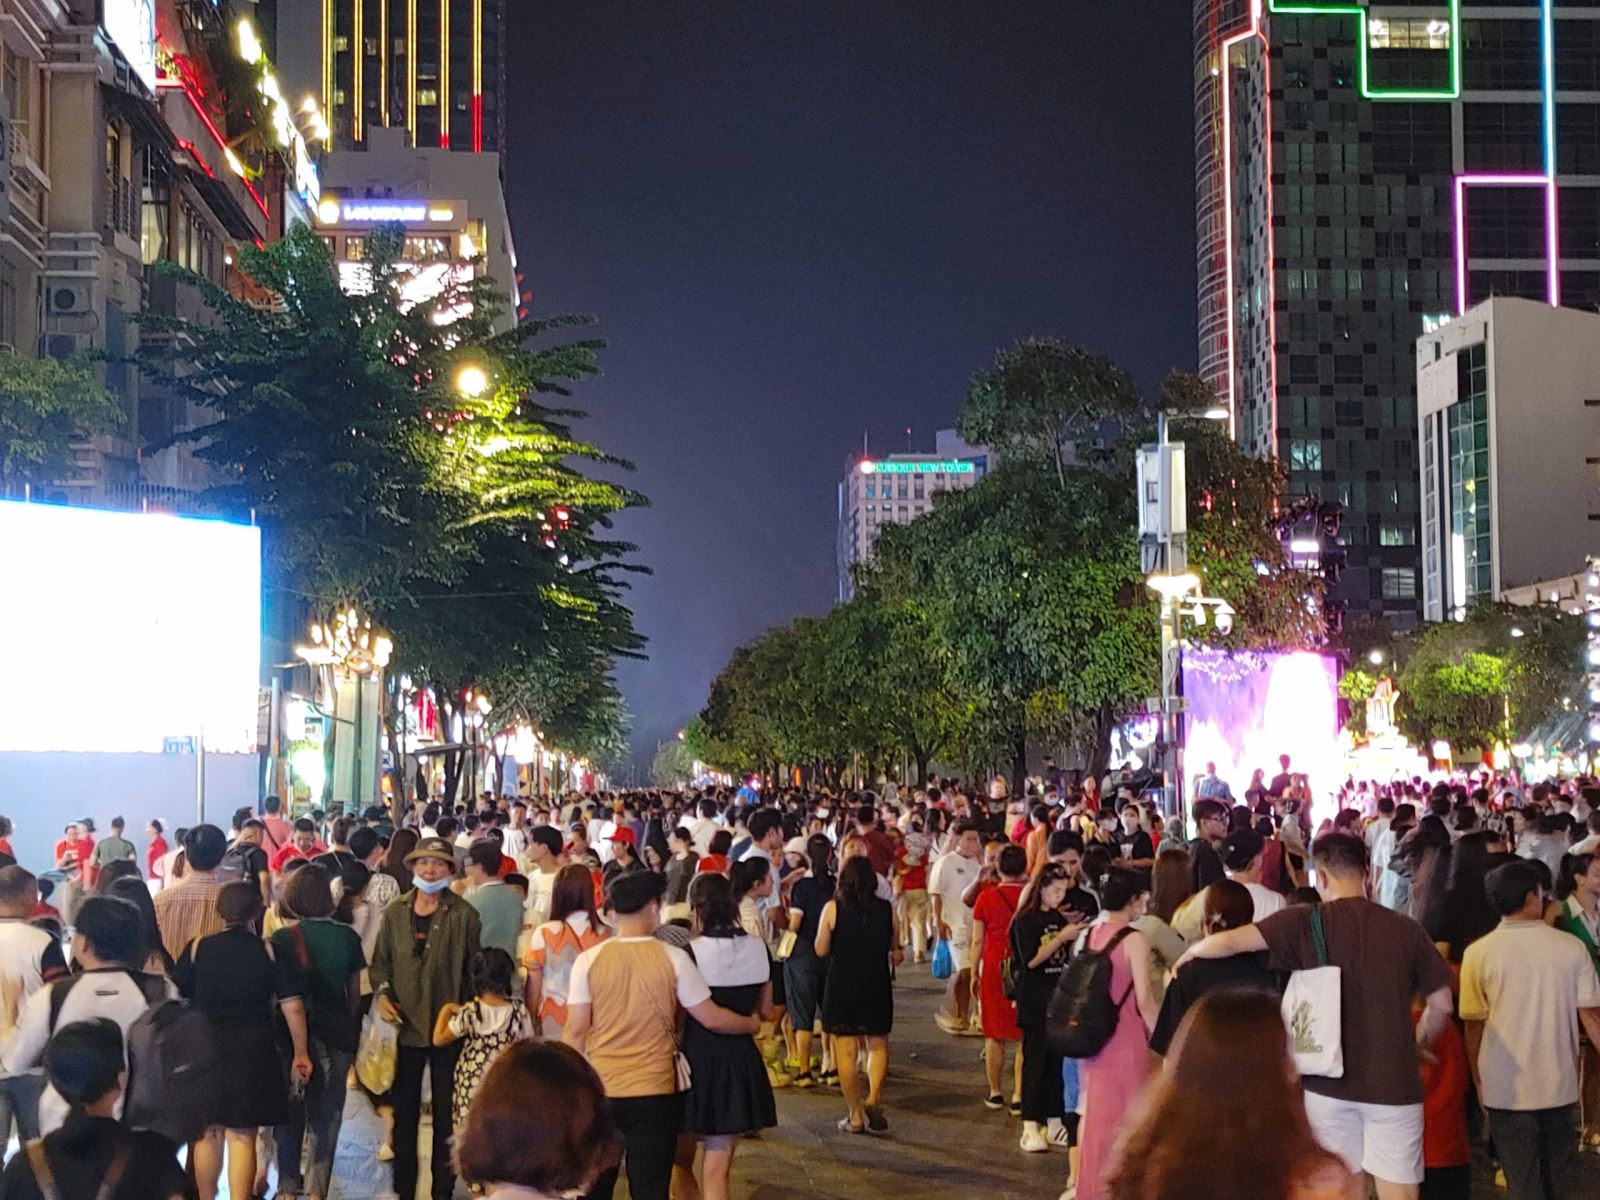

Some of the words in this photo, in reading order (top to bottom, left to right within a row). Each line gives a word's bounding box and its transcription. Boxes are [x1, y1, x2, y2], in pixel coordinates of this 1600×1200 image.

[872, 461, 915, 473] HARBOUR
[917, 461, 939, 473] VIEW
[940, 461, 974, 473] TOWER
